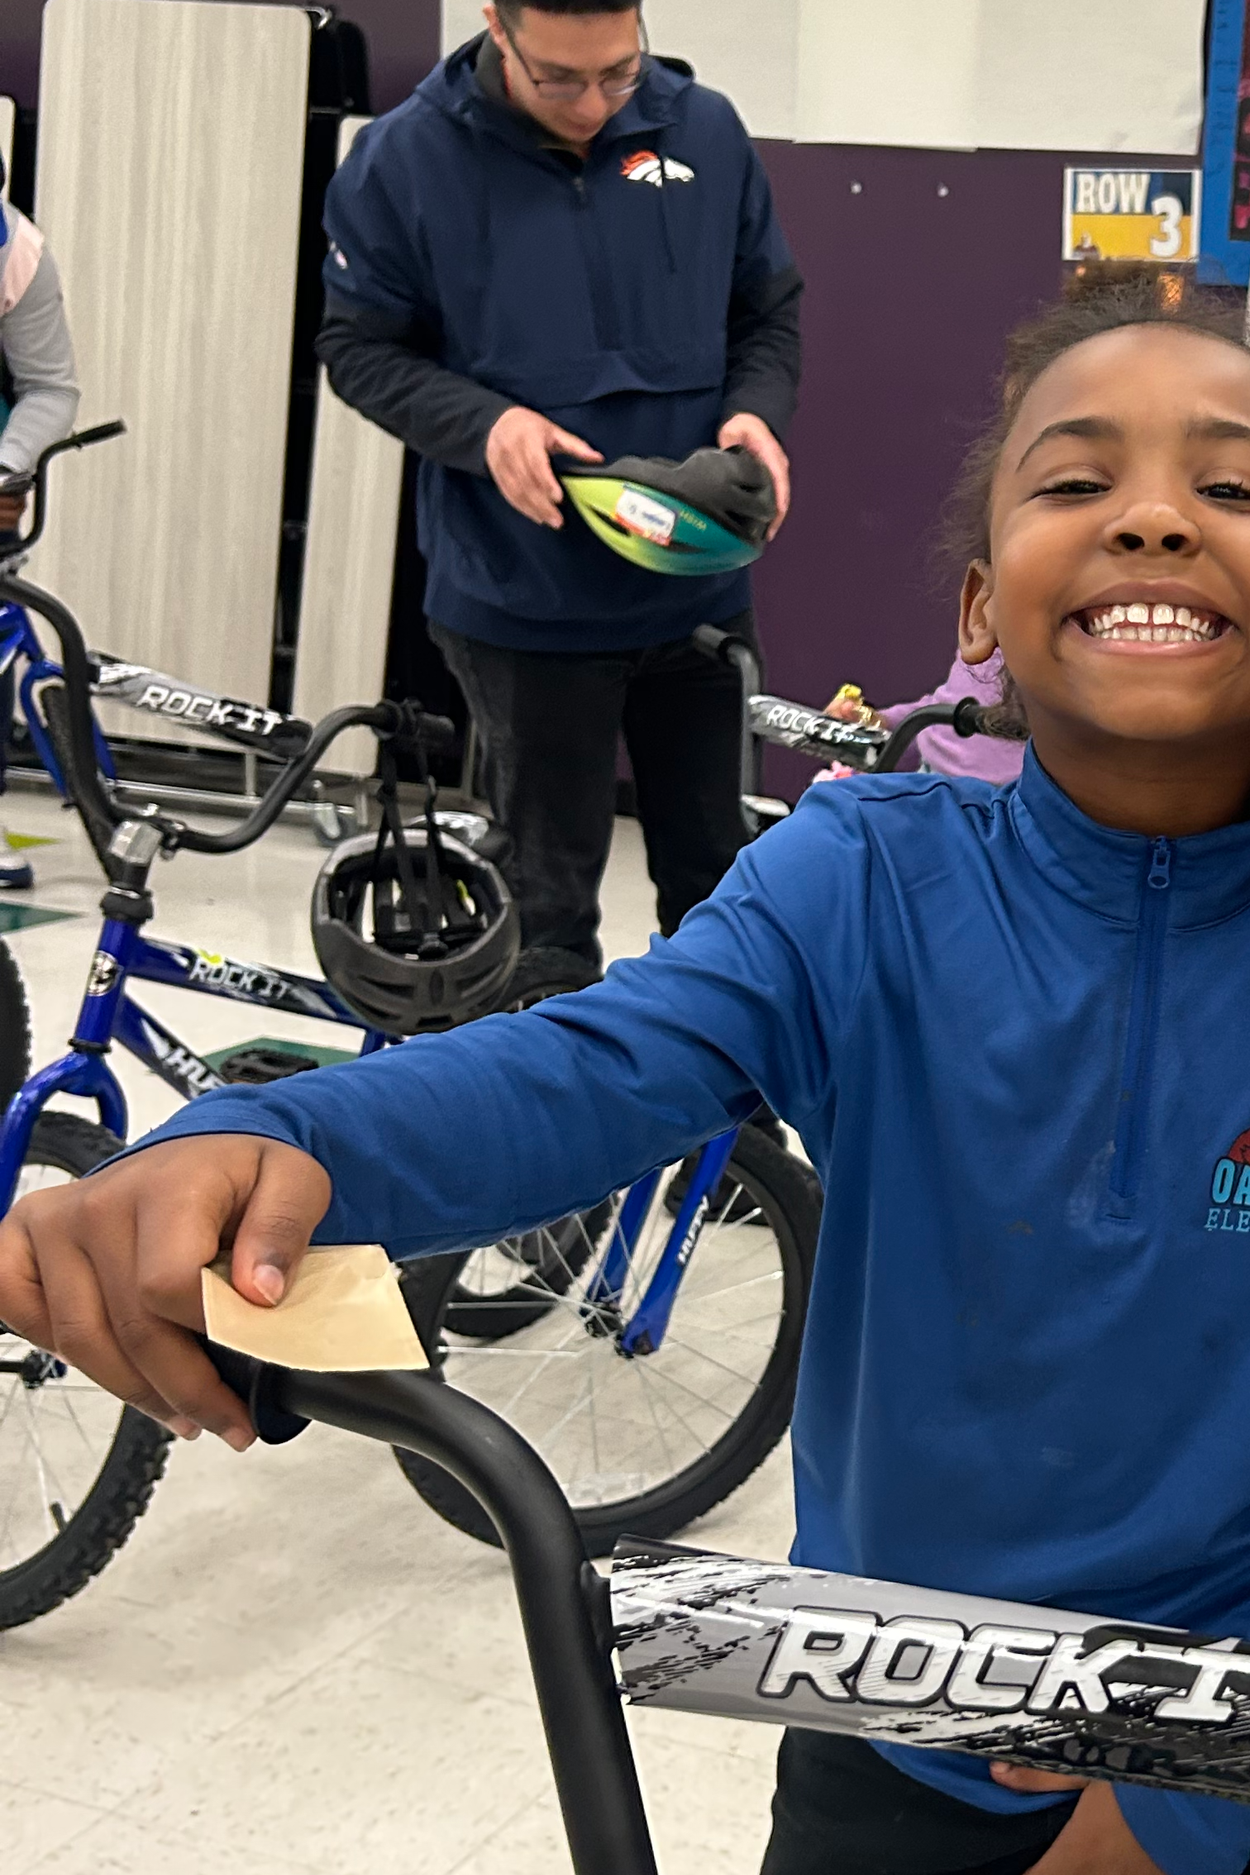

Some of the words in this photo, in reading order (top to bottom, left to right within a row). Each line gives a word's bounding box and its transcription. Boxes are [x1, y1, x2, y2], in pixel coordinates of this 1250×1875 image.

[1077, 173, 1151, 214] ROW
[1149, 195, 1183, 258] 3
[757, 1605, 1140, 1715] ROCK
